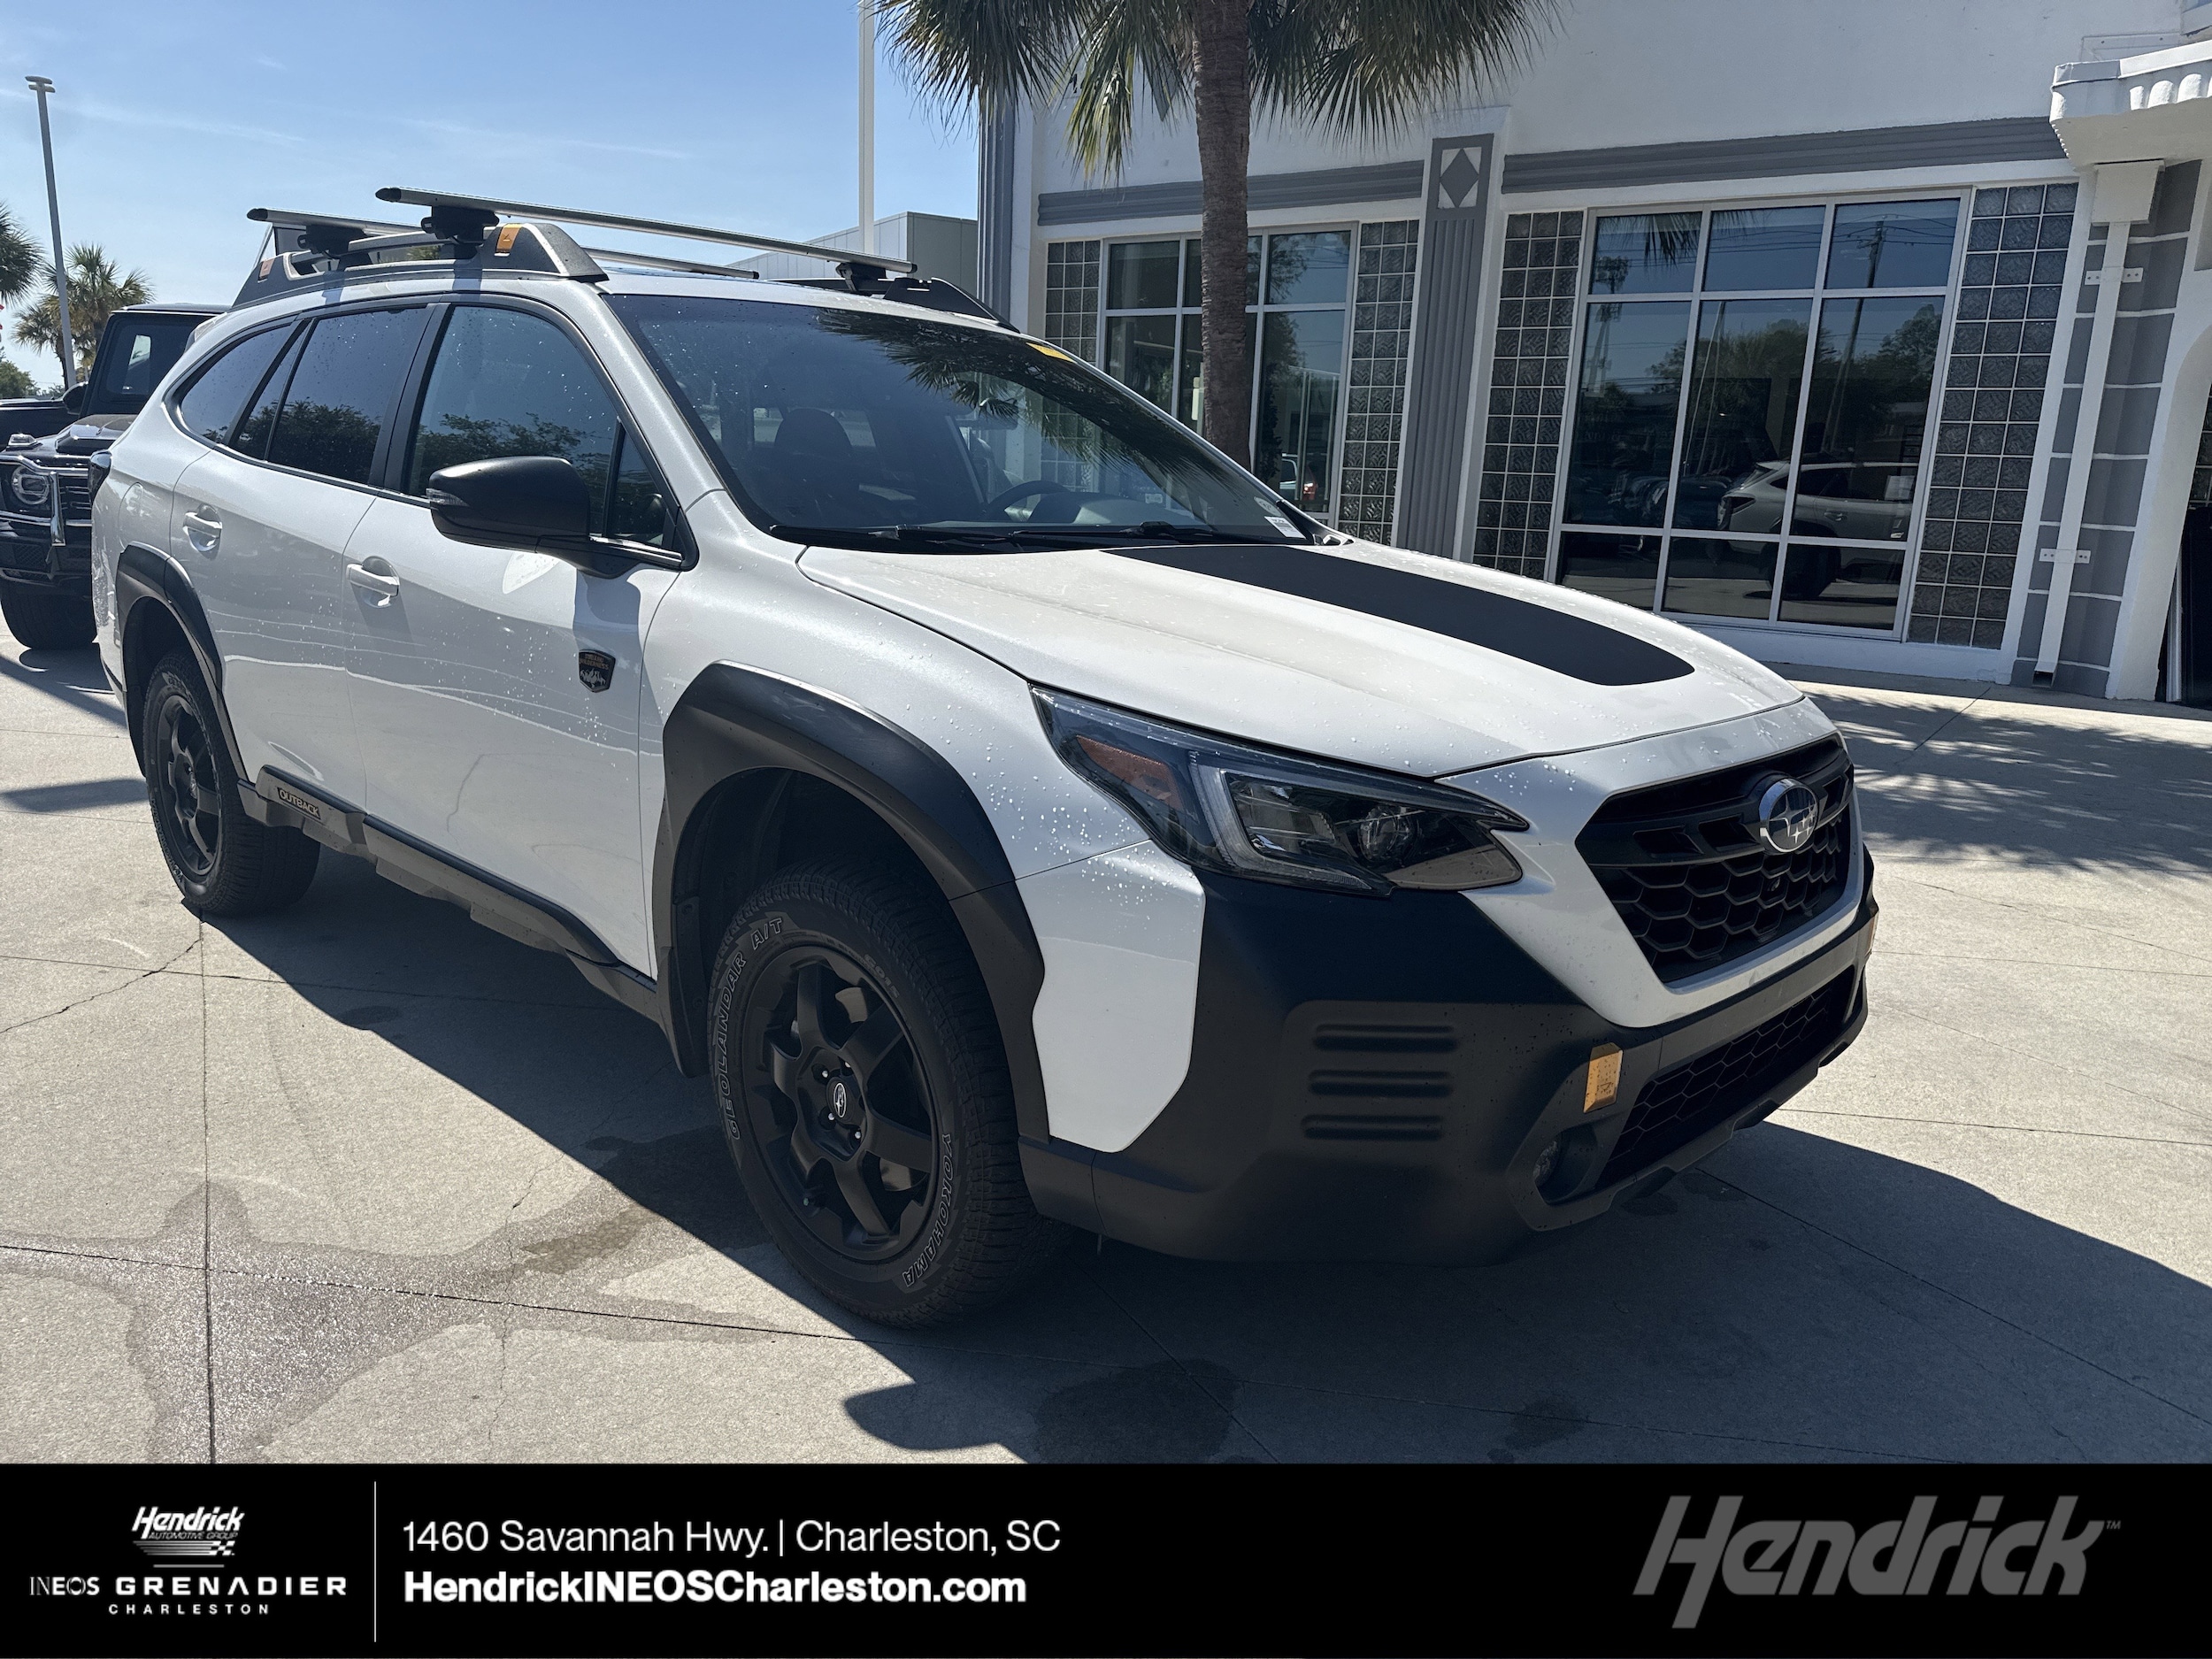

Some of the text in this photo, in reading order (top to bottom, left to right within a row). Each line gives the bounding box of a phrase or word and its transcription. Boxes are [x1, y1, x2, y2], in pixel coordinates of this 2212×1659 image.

[279, 789, 320, 817] OUTBACK
[714, 918, 783, 1141] GEOLANDAR A/T
[902, 1133, 954, 1288] YOKOHAMA
